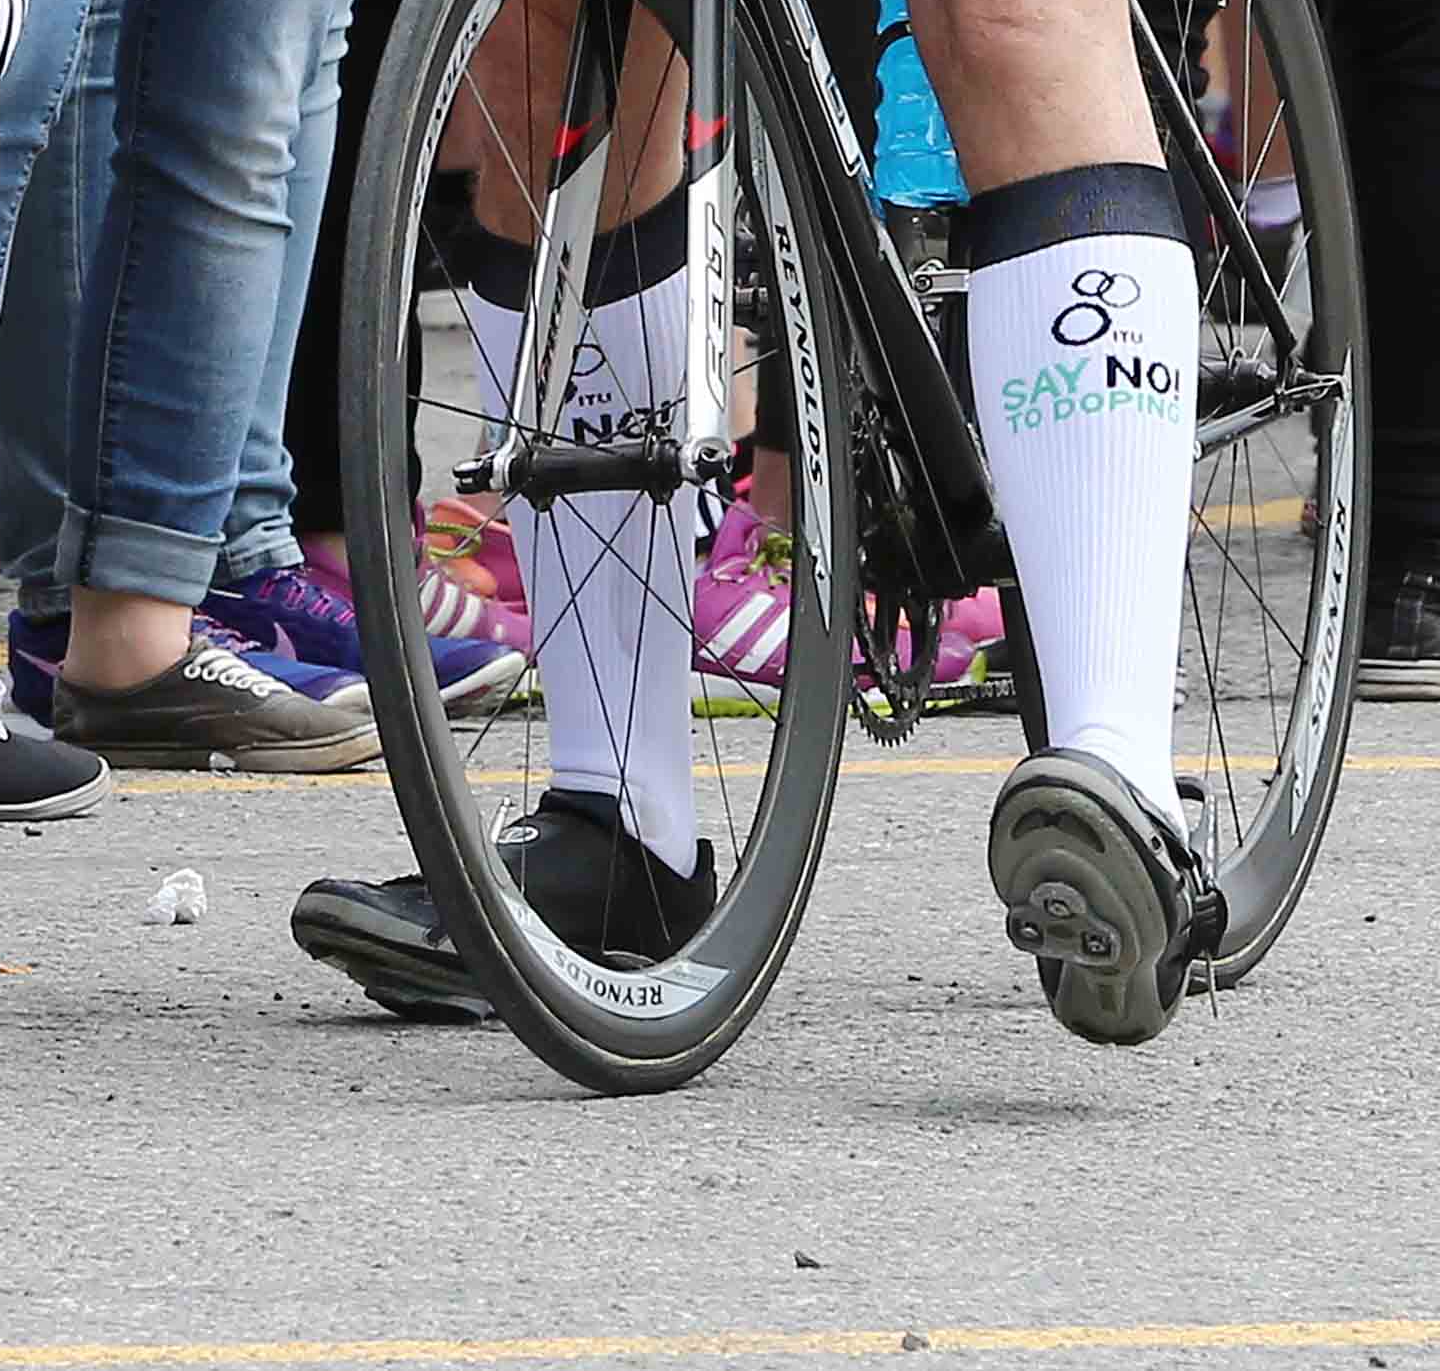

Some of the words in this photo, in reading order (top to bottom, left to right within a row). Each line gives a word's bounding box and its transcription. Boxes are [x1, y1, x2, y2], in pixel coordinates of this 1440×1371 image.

[773, 223, 824, 488] REYNOLDS
[1001, 357, 1091, 412] SAY
[1105, 355, 1181, 401] NO!
[1007, 408, 1042, 434] TO
[1053, 390, 1185, 424] DOPING
[552, 948, 664, 1007] REYNOLDS
